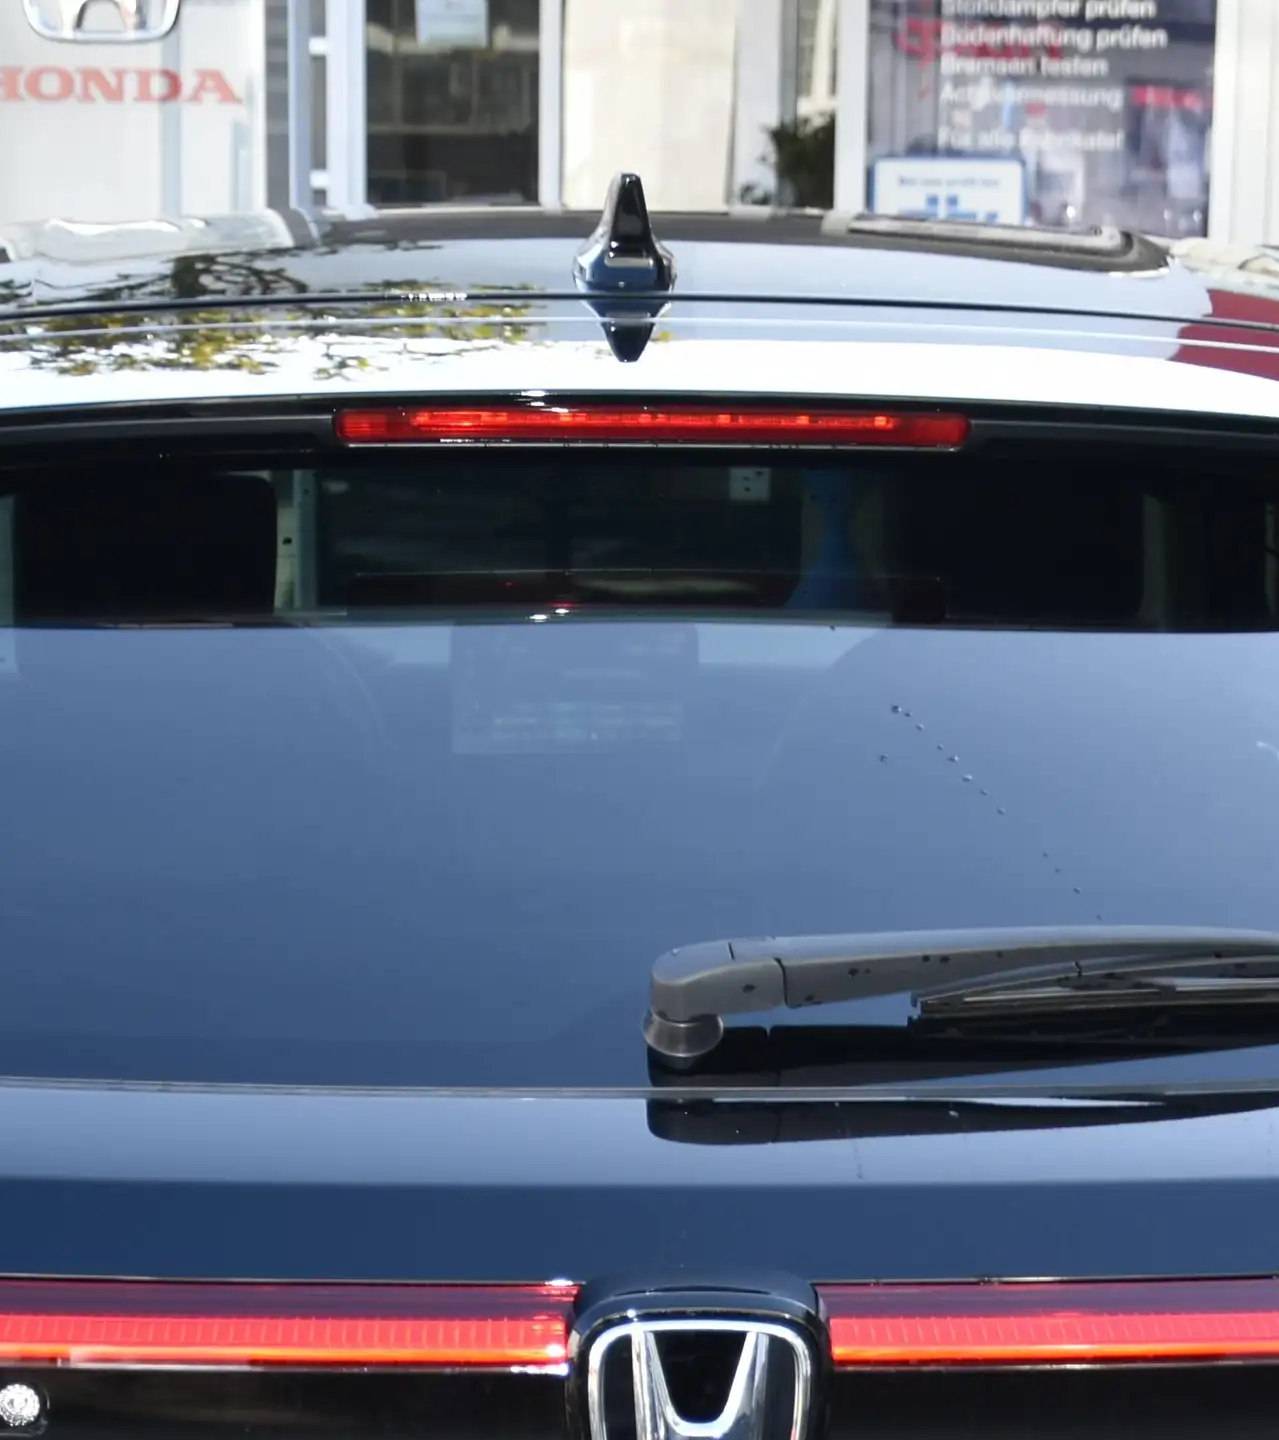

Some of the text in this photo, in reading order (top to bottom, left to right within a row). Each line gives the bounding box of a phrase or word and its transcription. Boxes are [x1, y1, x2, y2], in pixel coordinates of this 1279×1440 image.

[1096, 24, 1168, 51] prüfen
[940, 53, 1109, 76] Bremsen testen
